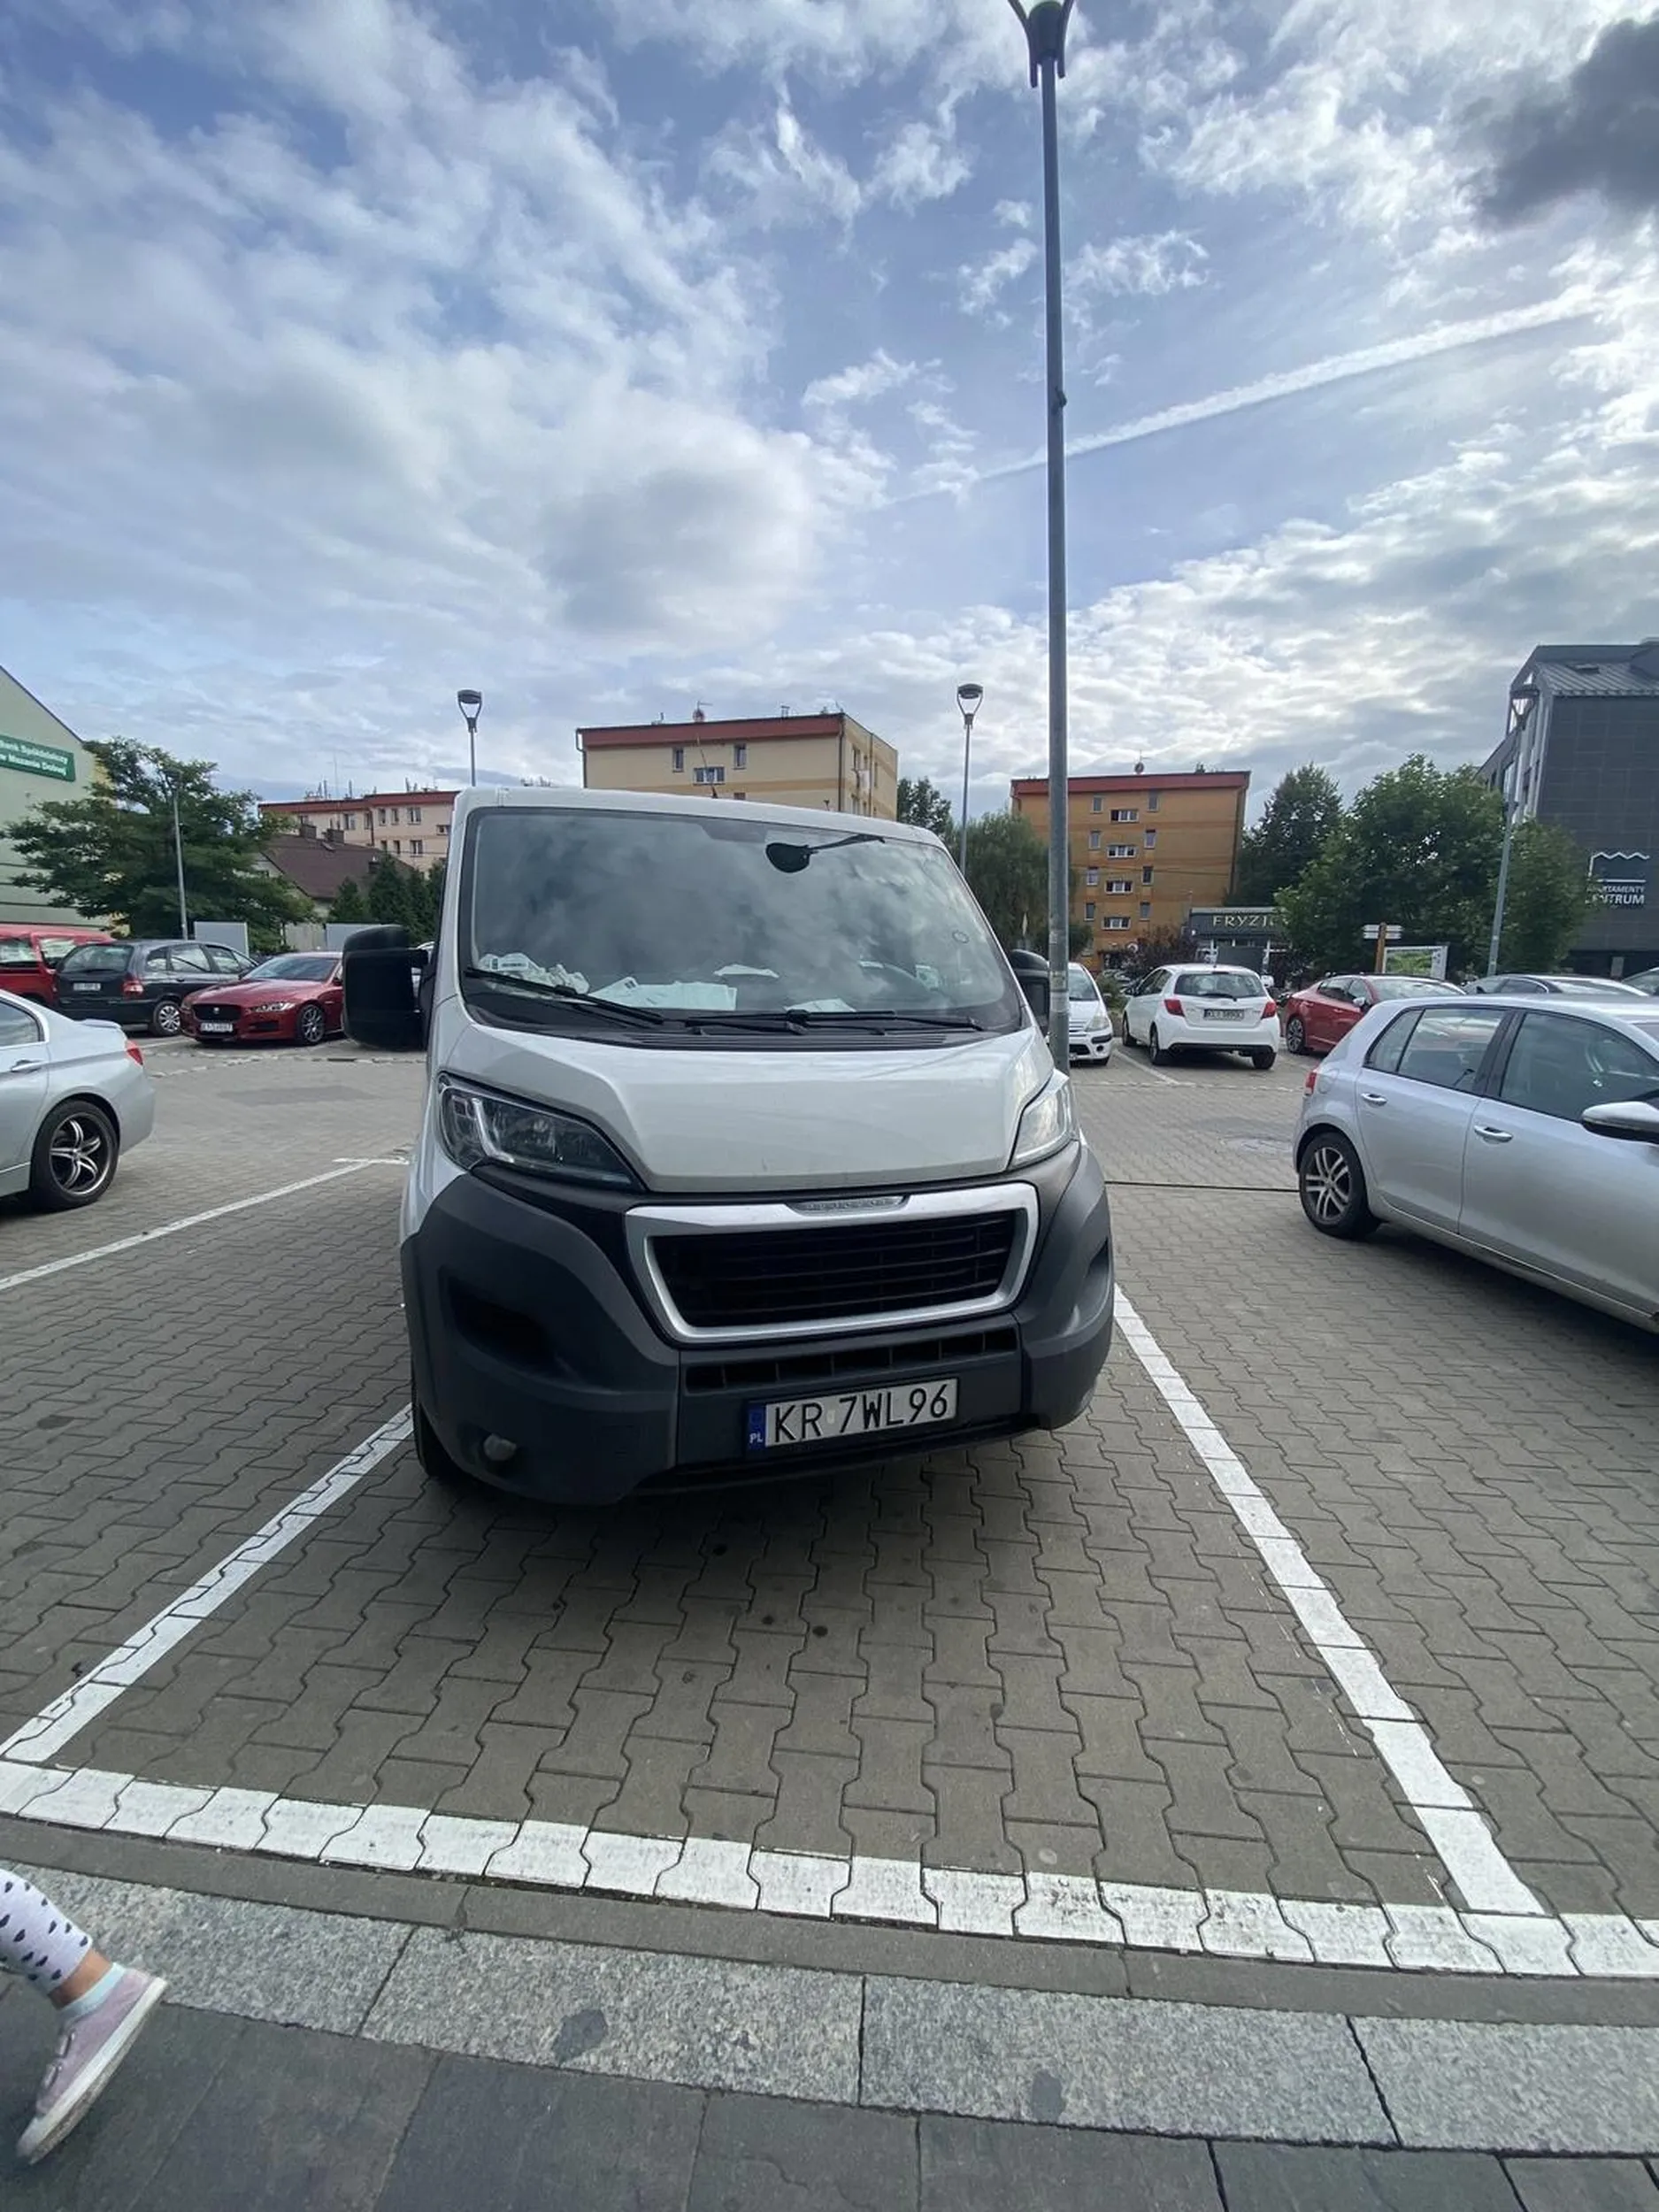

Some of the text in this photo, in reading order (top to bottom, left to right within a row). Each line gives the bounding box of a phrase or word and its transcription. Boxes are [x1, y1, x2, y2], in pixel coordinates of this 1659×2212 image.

[1585, 894, 1645, 904] ENTRUM
[774, 1384, 949, 1443] KR 7WL96
[749, 1432, 764, 1444] PL
